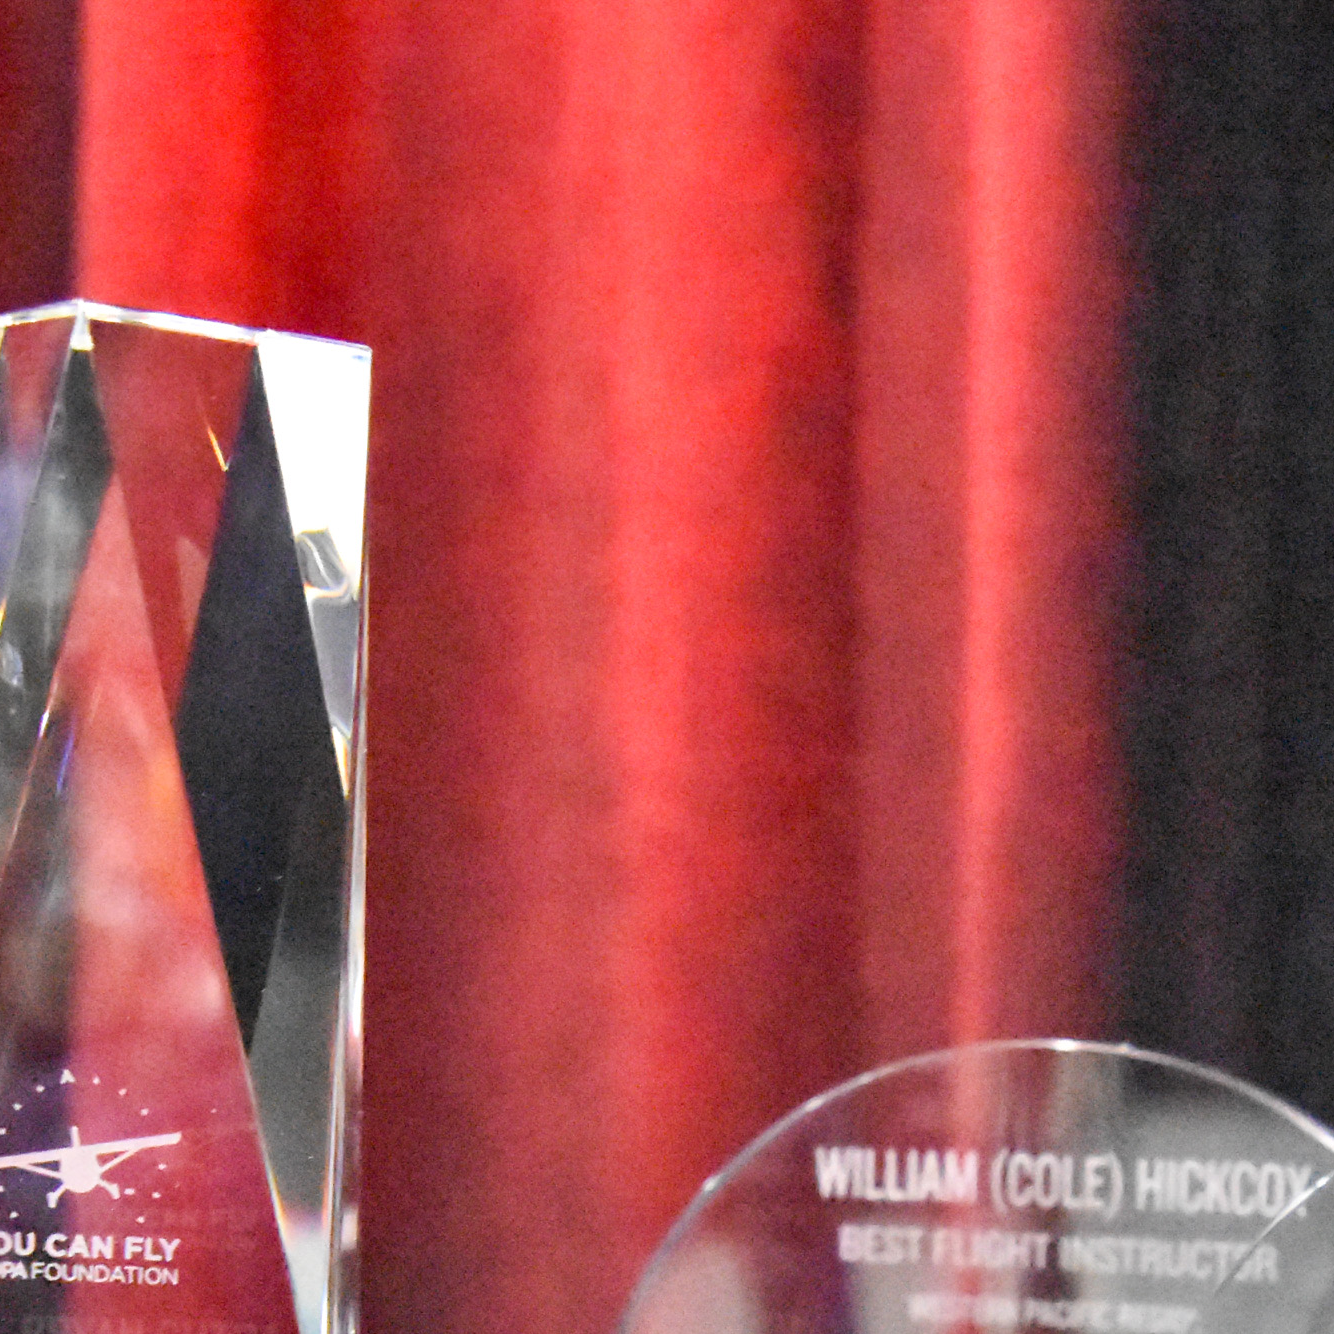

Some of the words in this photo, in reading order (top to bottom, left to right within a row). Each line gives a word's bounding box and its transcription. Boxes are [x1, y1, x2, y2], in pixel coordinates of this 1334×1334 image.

[815, 1146, 978, 1203] WILLIAM
[990, 1149, 1124, 1221] (COLE)
[44, 1233, 114, 1259] CAN
[123, 1237, 181, 1262] FLY
[838, 1223, 923, 1264] BEST
[932, 1228, 1050, 1269] FLIGHT
[30, 1262, 179, 1285] FOUNDATION
